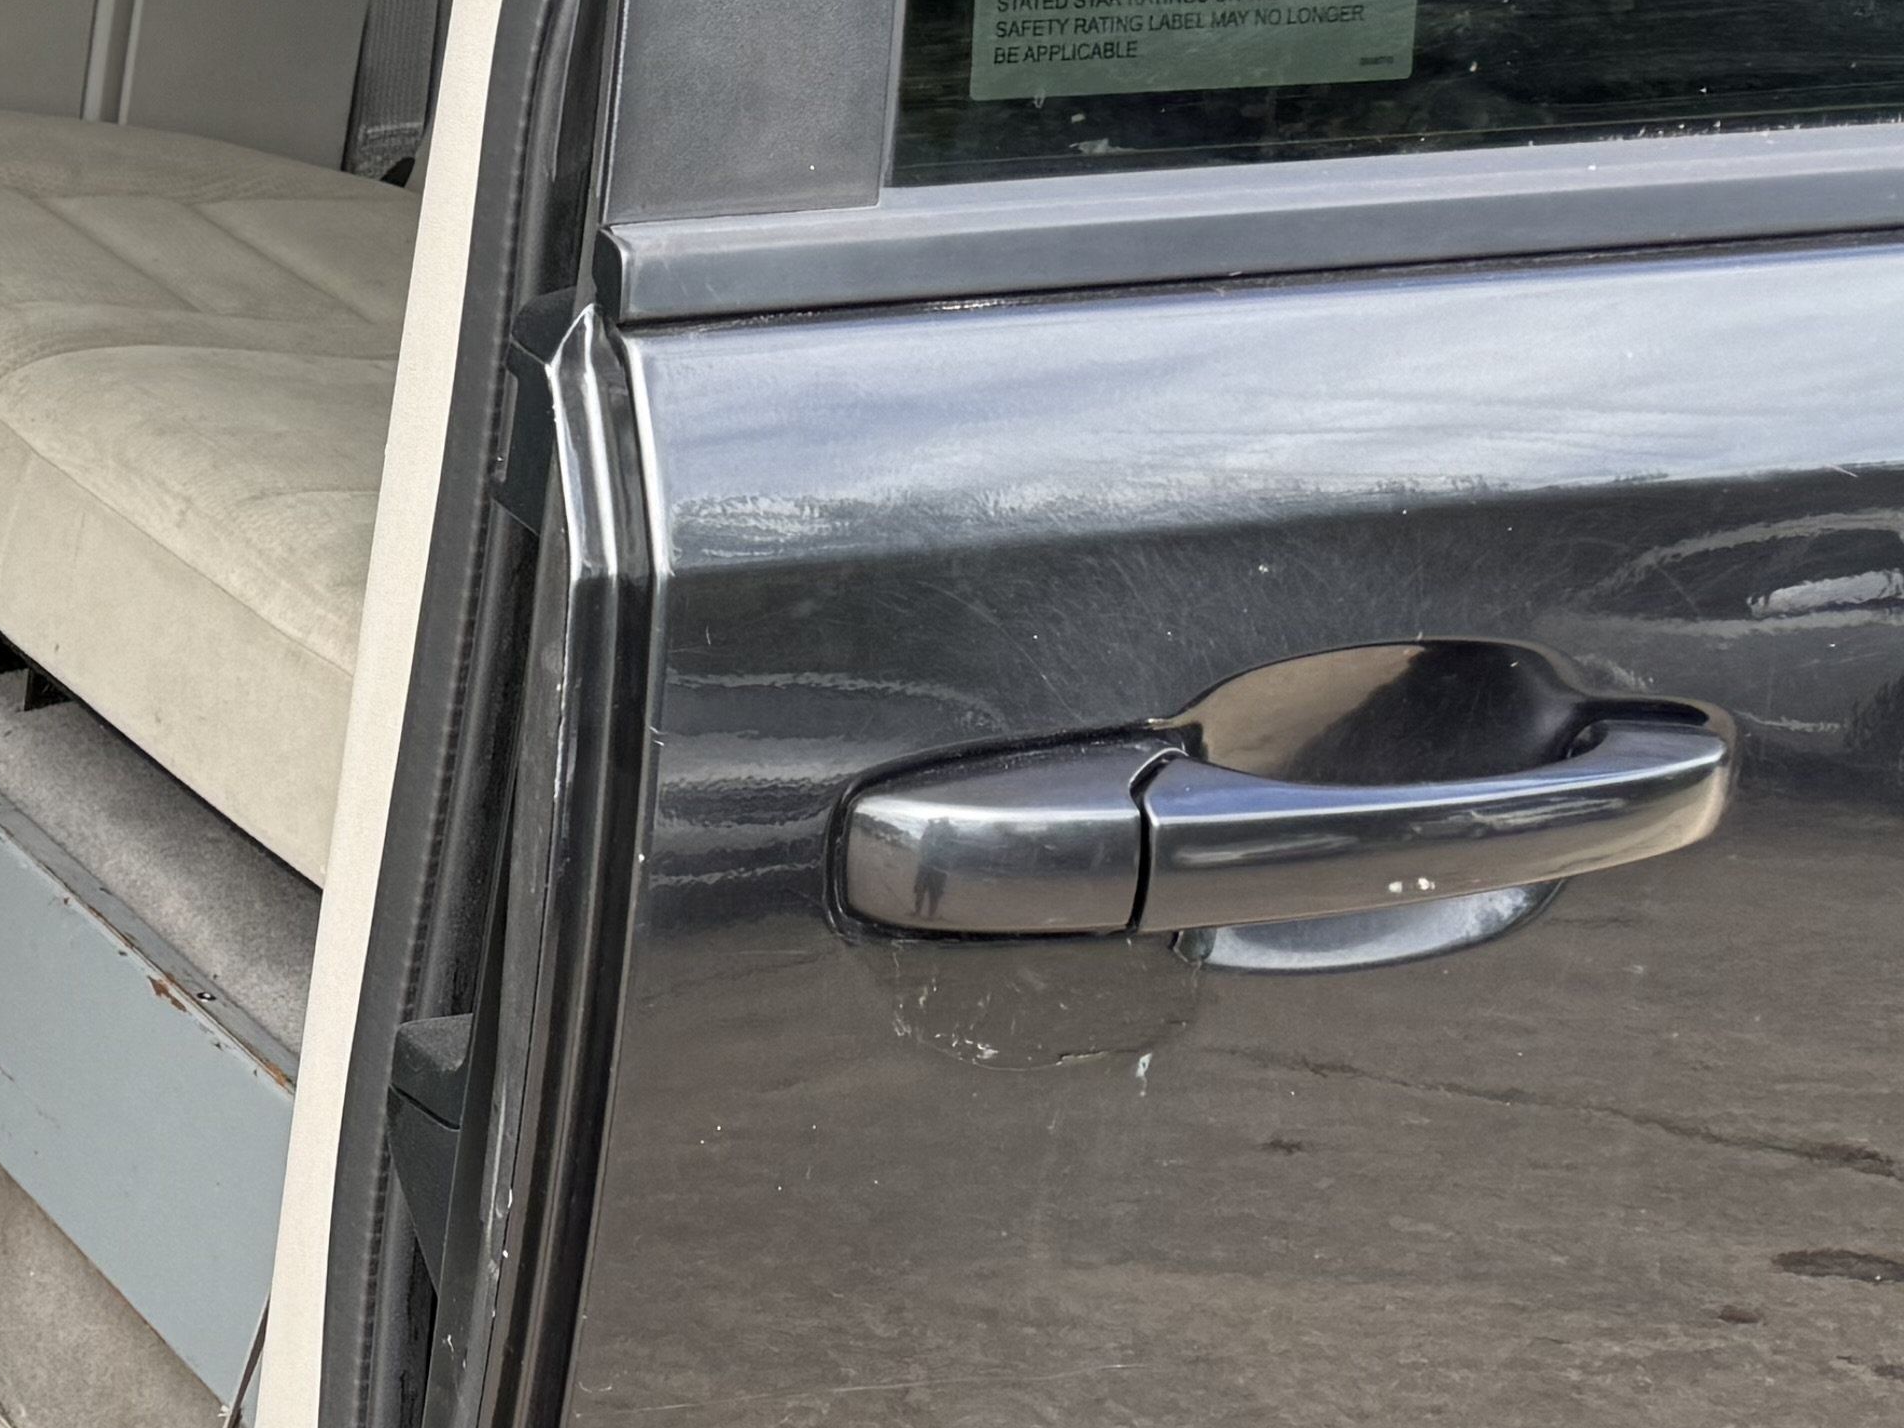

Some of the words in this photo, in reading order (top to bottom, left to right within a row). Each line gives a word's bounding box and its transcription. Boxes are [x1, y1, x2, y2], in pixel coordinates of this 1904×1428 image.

[995, 18, 1070, 39] SAFETY
[1073, 14, 1143, 35] RATING
[1148, 11, 1205, 32] LABEL
[1210, 8, 1251, 28] MAY
[1254, 7, 1283, 26] NO
[1286, 3, 1365, 24] LONGER
[994, 46, 1020, 65] BE
[1022, 40, 1138, 63] APPLICABLE
